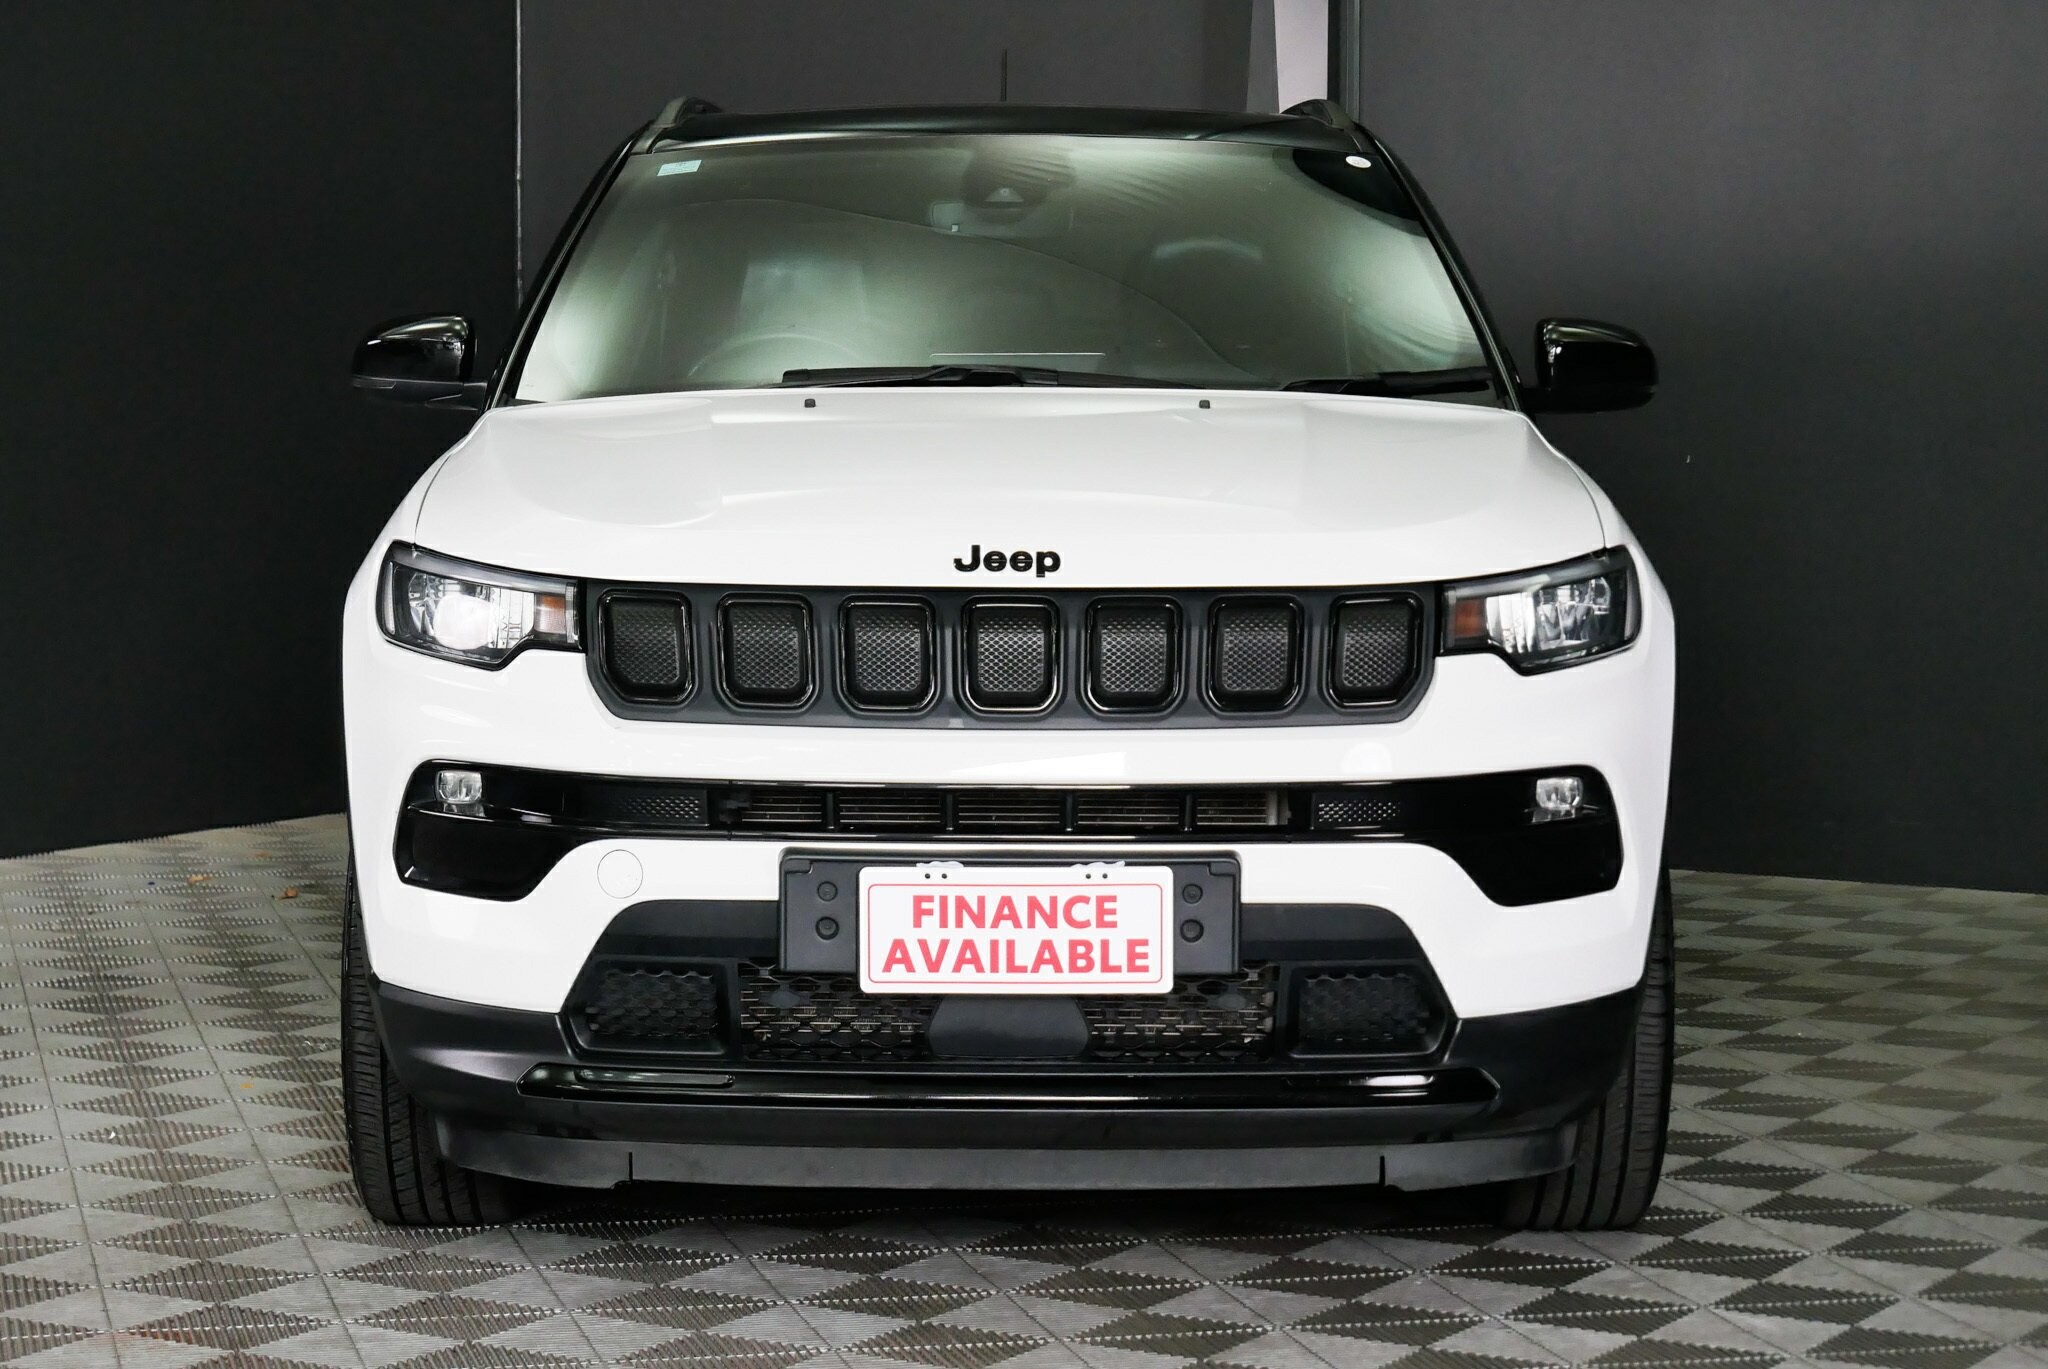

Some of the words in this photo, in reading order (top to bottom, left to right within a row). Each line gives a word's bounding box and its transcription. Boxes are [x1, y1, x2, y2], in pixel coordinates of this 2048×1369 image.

[953, 544, 1061, 578] Jeep
[912, 895, 1118, 929] FINANCE
[882, 938, 1150, 974] AVAILABLE
